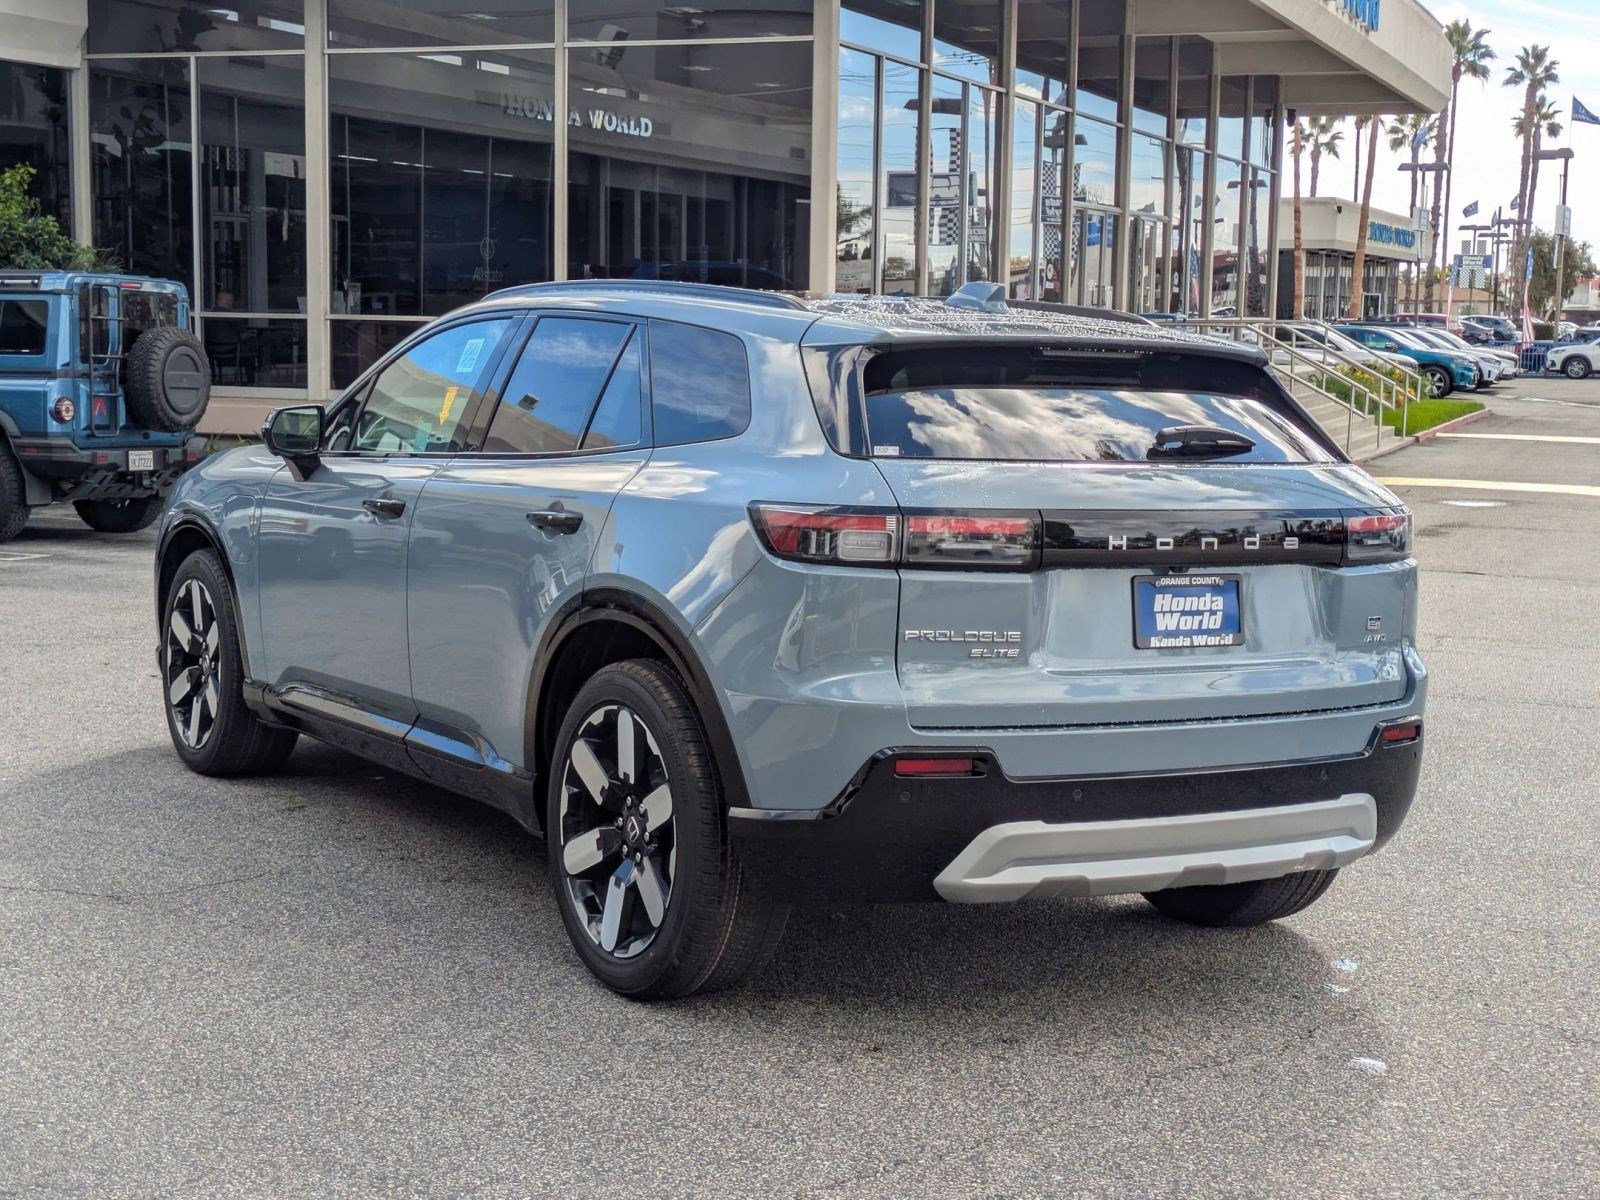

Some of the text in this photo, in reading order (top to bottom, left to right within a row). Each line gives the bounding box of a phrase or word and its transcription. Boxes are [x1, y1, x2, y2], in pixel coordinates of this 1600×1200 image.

[504, 94, 653, 138] HONA WORLD
[1160, 576, 1220, 585] ORANGE COUNTY
[1153, 592, 1224, 612] Honda
[1155, 611, 1223, 631] World
[904, 630, 1021, 643] PROLOGUE
[1150, 633, 1233, 648] Honda World
[969, 648, 1020, 658] ELITE
